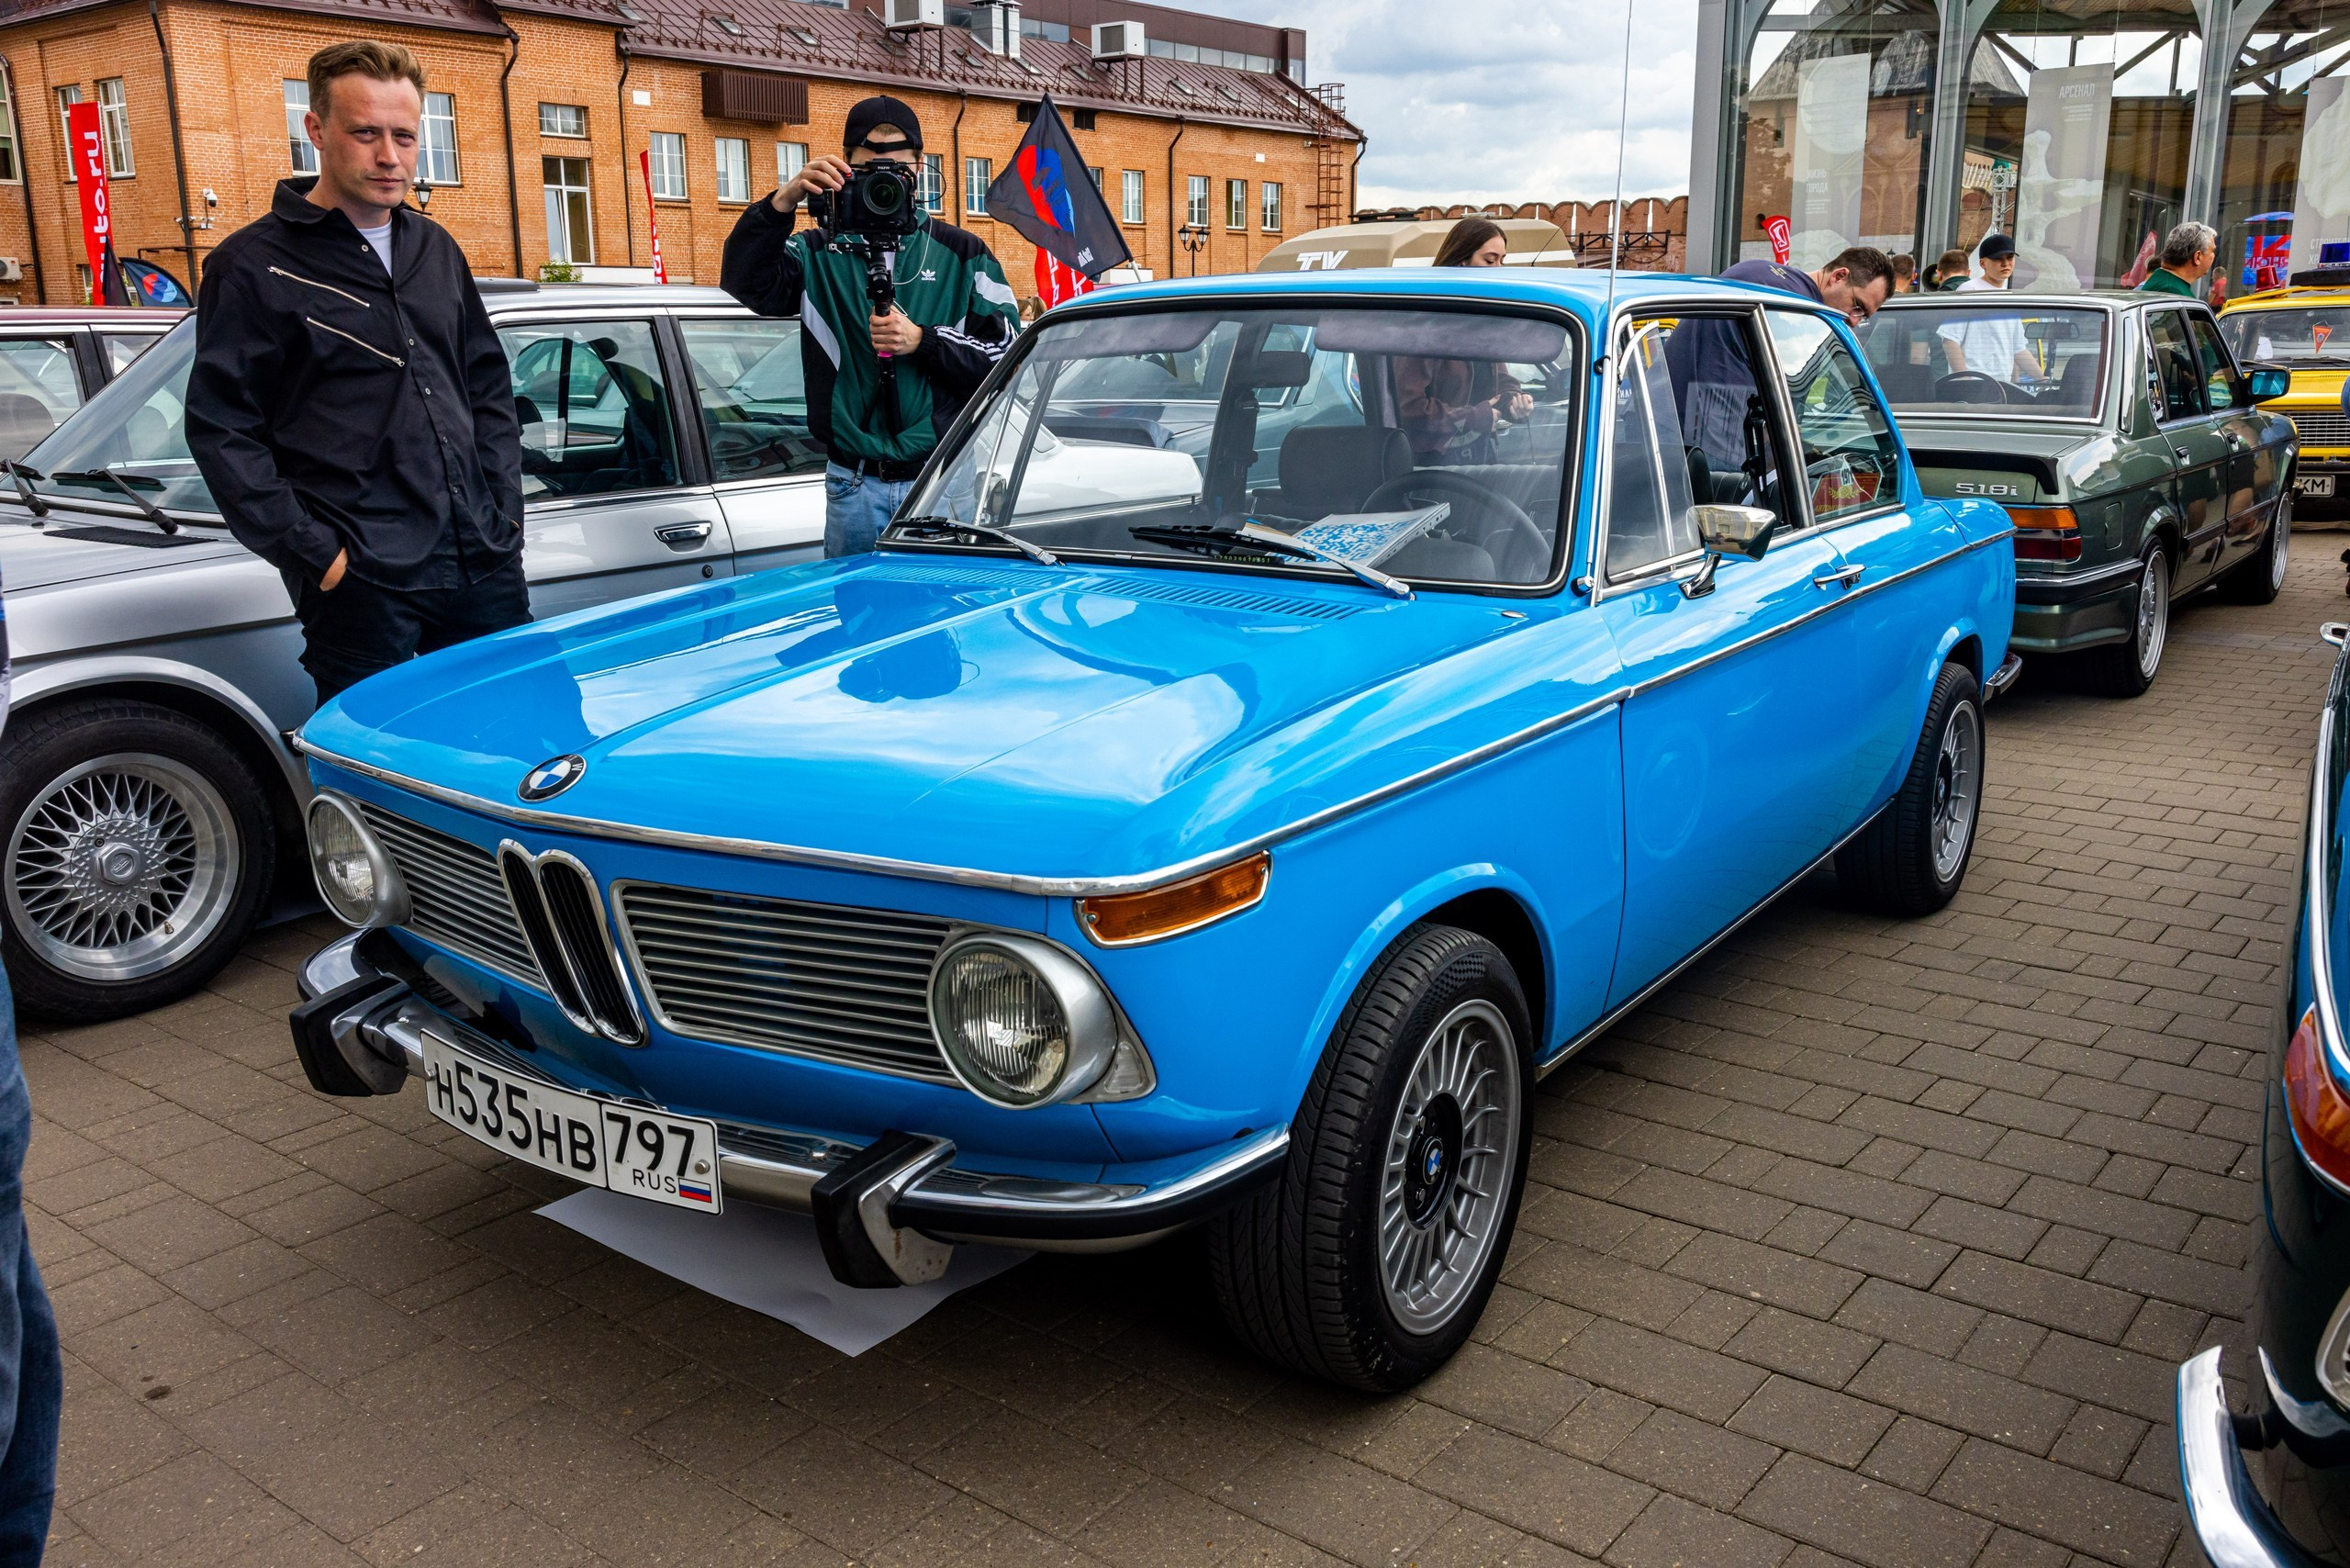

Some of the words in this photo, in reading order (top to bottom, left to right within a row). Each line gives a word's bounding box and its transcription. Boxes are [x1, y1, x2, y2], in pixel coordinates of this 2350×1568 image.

[2058, 84, 2095, 99] АРСЕНАЛ
[1806, 169, 1827, 180] ЖИЗНЬ
[1806, 183, 1829, 194] ГОРОДА
[1955, 482, 2018, 497] 518i
[606, 1111, 695, 1177] 797
[632, 1168, 677, 1194] RUS
